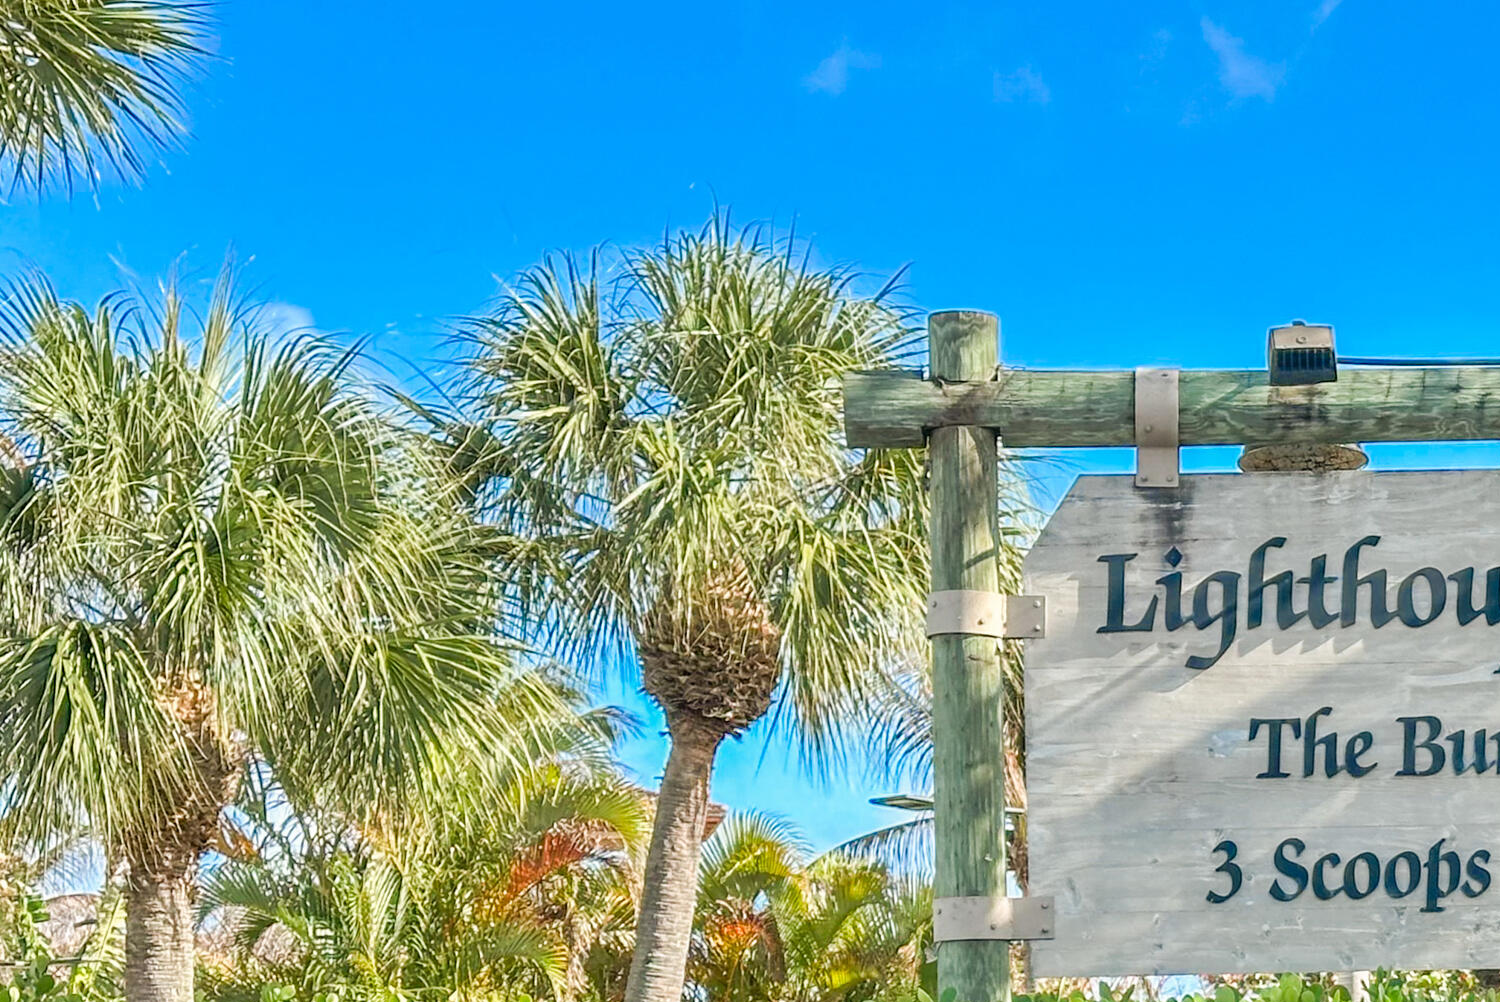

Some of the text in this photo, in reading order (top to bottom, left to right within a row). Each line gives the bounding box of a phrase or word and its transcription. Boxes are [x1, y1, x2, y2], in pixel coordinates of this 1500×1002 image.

[1248, 706, 1379, 780] The
[1206, 840, 1243, 904] 3
[1268, 837, 1492, 914] Scoops
